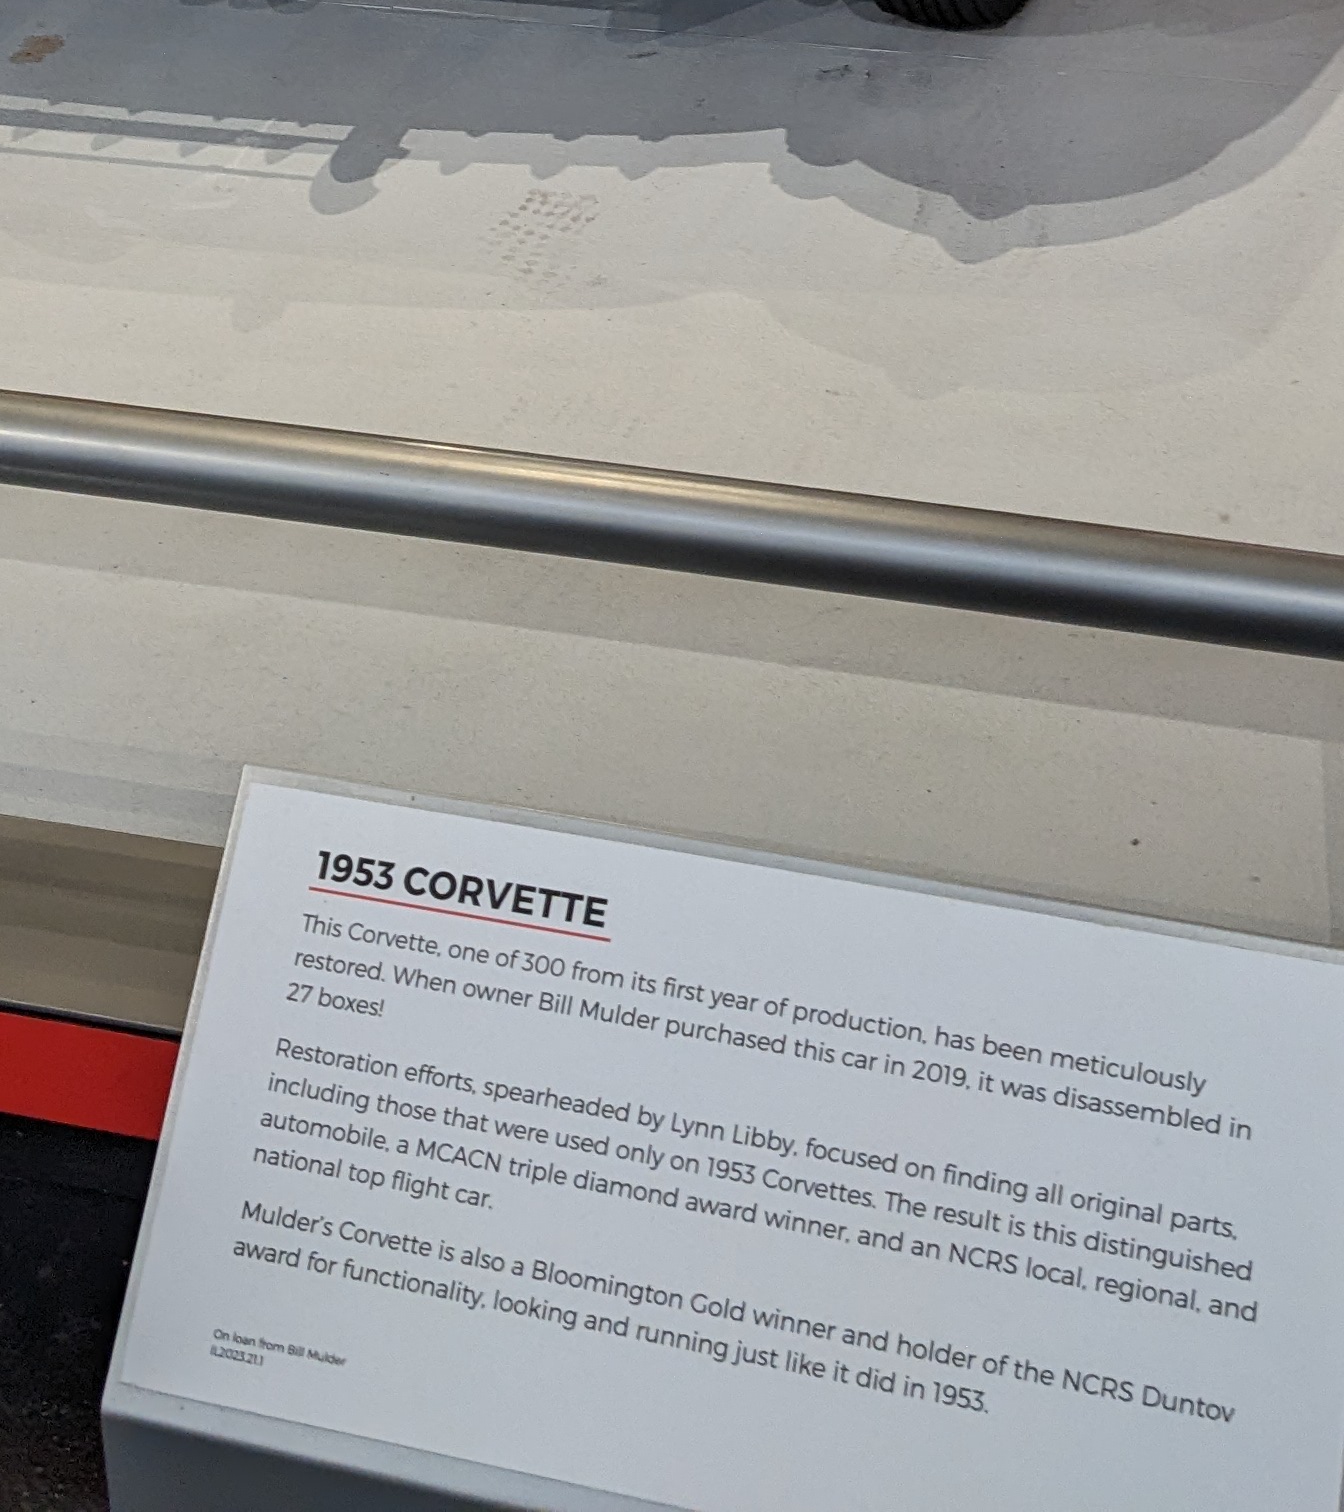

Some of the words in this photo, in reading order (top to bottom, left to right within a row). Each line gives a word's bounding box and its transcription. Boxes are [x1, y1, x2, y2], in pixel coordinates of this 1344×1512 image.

[316, 848, 397, 891] 1953
[401, 865, 609, 929] CORVETTE
[284, 980, 315, 1004] 27
[316, 984, 385, 1018] boxes!
[292, 950, 386, 983] restored.
[392, 963, 457, 995] When
[461, 981, 534, 1008] owner
[537, 990, 574, 1016] Bill
[578, 997, 661, 1032] Mulder
[662, 1017, 788, 1055] purchased
[792, 1037, 836, 1064] this
[839, 1050, 879, 1072] car
[882, 1052, 906, 1077] in
[910, 1058, 971, 1091] 2019,
[976, 1069, 995, 1093] it
[999, 1078, 1047, 1103] was
[1051, 1084, 1222, 1135] disassembled
[1228, 1115, 1252, 1141] in
[301, 911, 343, 938] This
[346, 921, 442, 958] Corvette,
[446, 942, 490, 964] one
[493, 948, 521, 970] of
[519, 950, 566, 978] 300
[570, 959, 625, 989] from
[629, 969, 657, 995] its
[661, 975, 706, 1003] first
[706, 988, 760, 1012] year
[762, 996, 790, 1018] of
[790, 1003, 927, 1045] production,
[933, 1024, 976, 1052] has
[980, 1032, 1043, 1065] been
[1048, 1050, 1207, 1098] meticulously
[251, 1146, 344, 1179] national
[346, 1161, 386, 1191] top
[390, 1168, 451, 1201] flight
[453, 1186, 493, 1210] car.
[258, 1111, 390, 1153] automobile,
[394, 1137, 410, 1155] a
[414, 1136, 503, 1173] MCACN
[507, 1156, 568, 1186] triple
[571, 1168, 680, 1208] diamond
[683, 1194, 759, 1224] award
[762, 1208, 851, 1244] winner,
[855, 1228, 905, 1253] and
[909, 1238, 941, 1260] an
[947, 1241, 1020, 1275] NCRS
[1024, 1255, 1087, 1291] local,
[1093, 1274, 1201, 1314] regional,
[1206, 1297, 1259, 1324] and
[266, 1070, 371, 1115] including
[375, 1092, 437, 1123] those
[441, 1105, 490, 1133] that
[493, 1118, 550, 1145] were
[553, 1130, 611, 1157] used
[614, 1142, 666, 1171] only
[668, 1153, 700, 1175] on
[706, 1155, 757, 1185] 1953
[760, 1167, 877, 1209] Corvettes.
[883, 1189, 928, 1219] The
[931, 1204, 1002, 1233] result
[1006, 1212, 1026, 1238] is
[1032, 1219, 1078, 1248] this
[1082, 1229, 1254, 1282] distinguished
[274, 1036, 399, 1079] Restoration
[403, 1062, 477, 1096] efforts,
[480, 1080, 632, 1123] spearheaded
[635, 1103, 666, 1134] by
[669, 1110, 725, 1142] Lynn
[731, 1122, 798, 1158] Libby,
[804, 1136, 899, 1175] focused
[903, 1160, 936, 1182] on
[941, 1161, 1029, 1204] finding
[1033, 1181, 1064, 1206] all
[1068, 1190, 1163, 1225] original
[1168, 1210, 1237, 1241] parts,
[211, 1327, 231, 1342] On
[230, 1330, 257, 1347] loan
[257, 1336, 285, 1353] from
[285, 1343, 306, 1358] Bill
[305, 1348, 347, 1366] Mulder
[232, 1239, 302, 1269] award
[305, 1249, 339, 1276] for
[341, 1256, 486, 1311] functionality,
[491, 1288, 579, 1332] looking
[582, 1313, 631, 1338] and
[634, 1323, 730, 1363] running
[729, 1338, 780, 1369] just
[784, 1348, 827, 1379] like
[831, 1359, 851, 1385] it
[854, 1365, 897, 1395] did
[901, 1373, 926, 1400] in
[932, 1379, 989, 1415] 1953.
[337, 1219, 433, 1258] Corvette
[436, 1238, 456, 1263] is
[458, 1245, 506, 1273] also
[509, 1259, 525, 1277] a
[529, 1258, 684, 1310] Bloomington
[688, 1291, 747, 1323] Gold
[751, 1307, 838, 1341] winner
[840, 1326, 890, 1353] and
[895, 1332, 978, 1370] holder
[980, 1353, 1011, 1377] of
[1012, 1357, 1056, 1387] the
[1061, 1367, 1135, 1403] NCRS
[1140, 1383, 1236, 1423] Duntov
